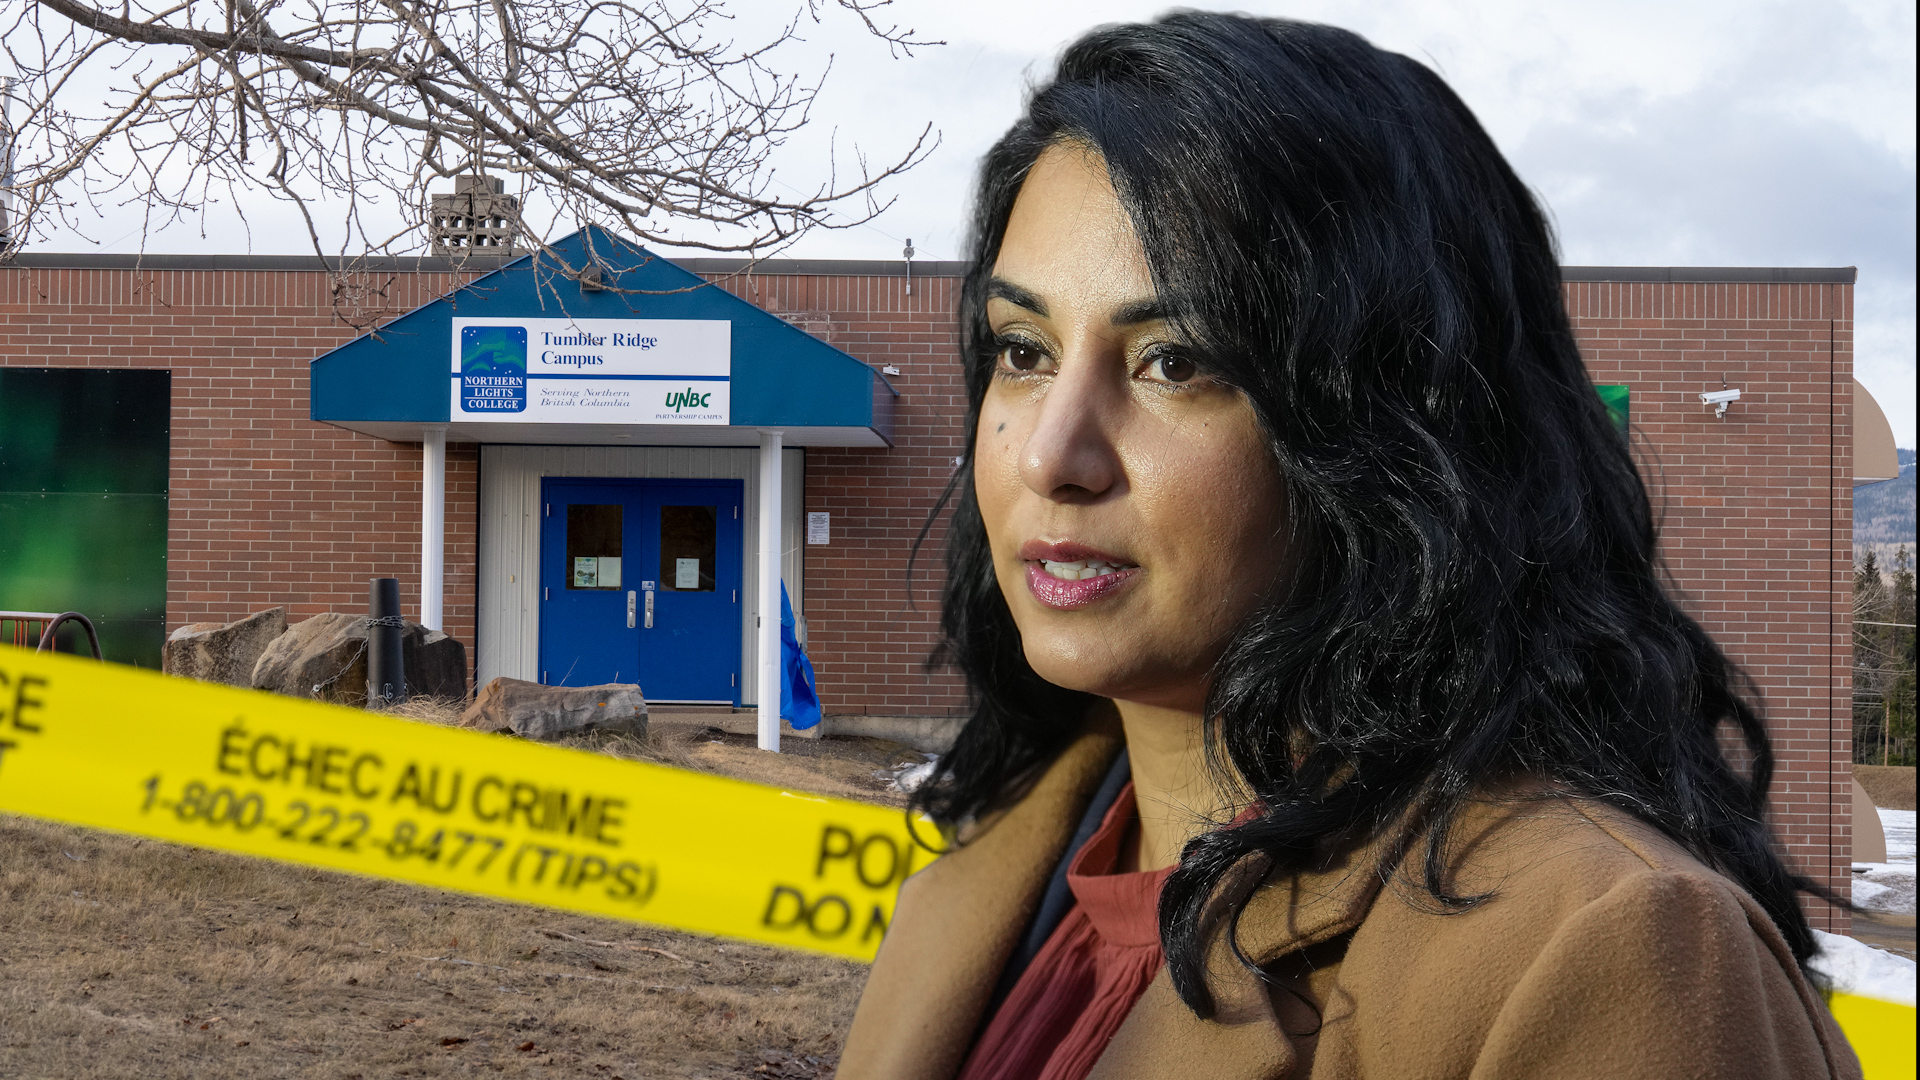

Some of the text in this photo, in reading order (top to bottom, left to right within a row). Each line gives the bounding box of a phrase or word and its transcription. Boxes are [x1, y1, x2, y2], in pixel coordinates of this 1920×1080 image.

[541, 331, 658, 350] Tumbler Ridge
[541, 350, 603, 368] Campus
[465, 376, 523, 386] NORTHERN
[474, 387, 513, 397] LIGHTS
[540, 388, 630, 398] Serving Northern
[665, 387, 712, 413] UNBC
[468, 399, 519, 409] COLLEGE
[540, 398, 630, 407] British Columbia
[217, 714, 628, 848] ÉCHEC AU CRIME
[508, 841, 659, 909] (TIPS)
[761, 884, 852, 941] DO
